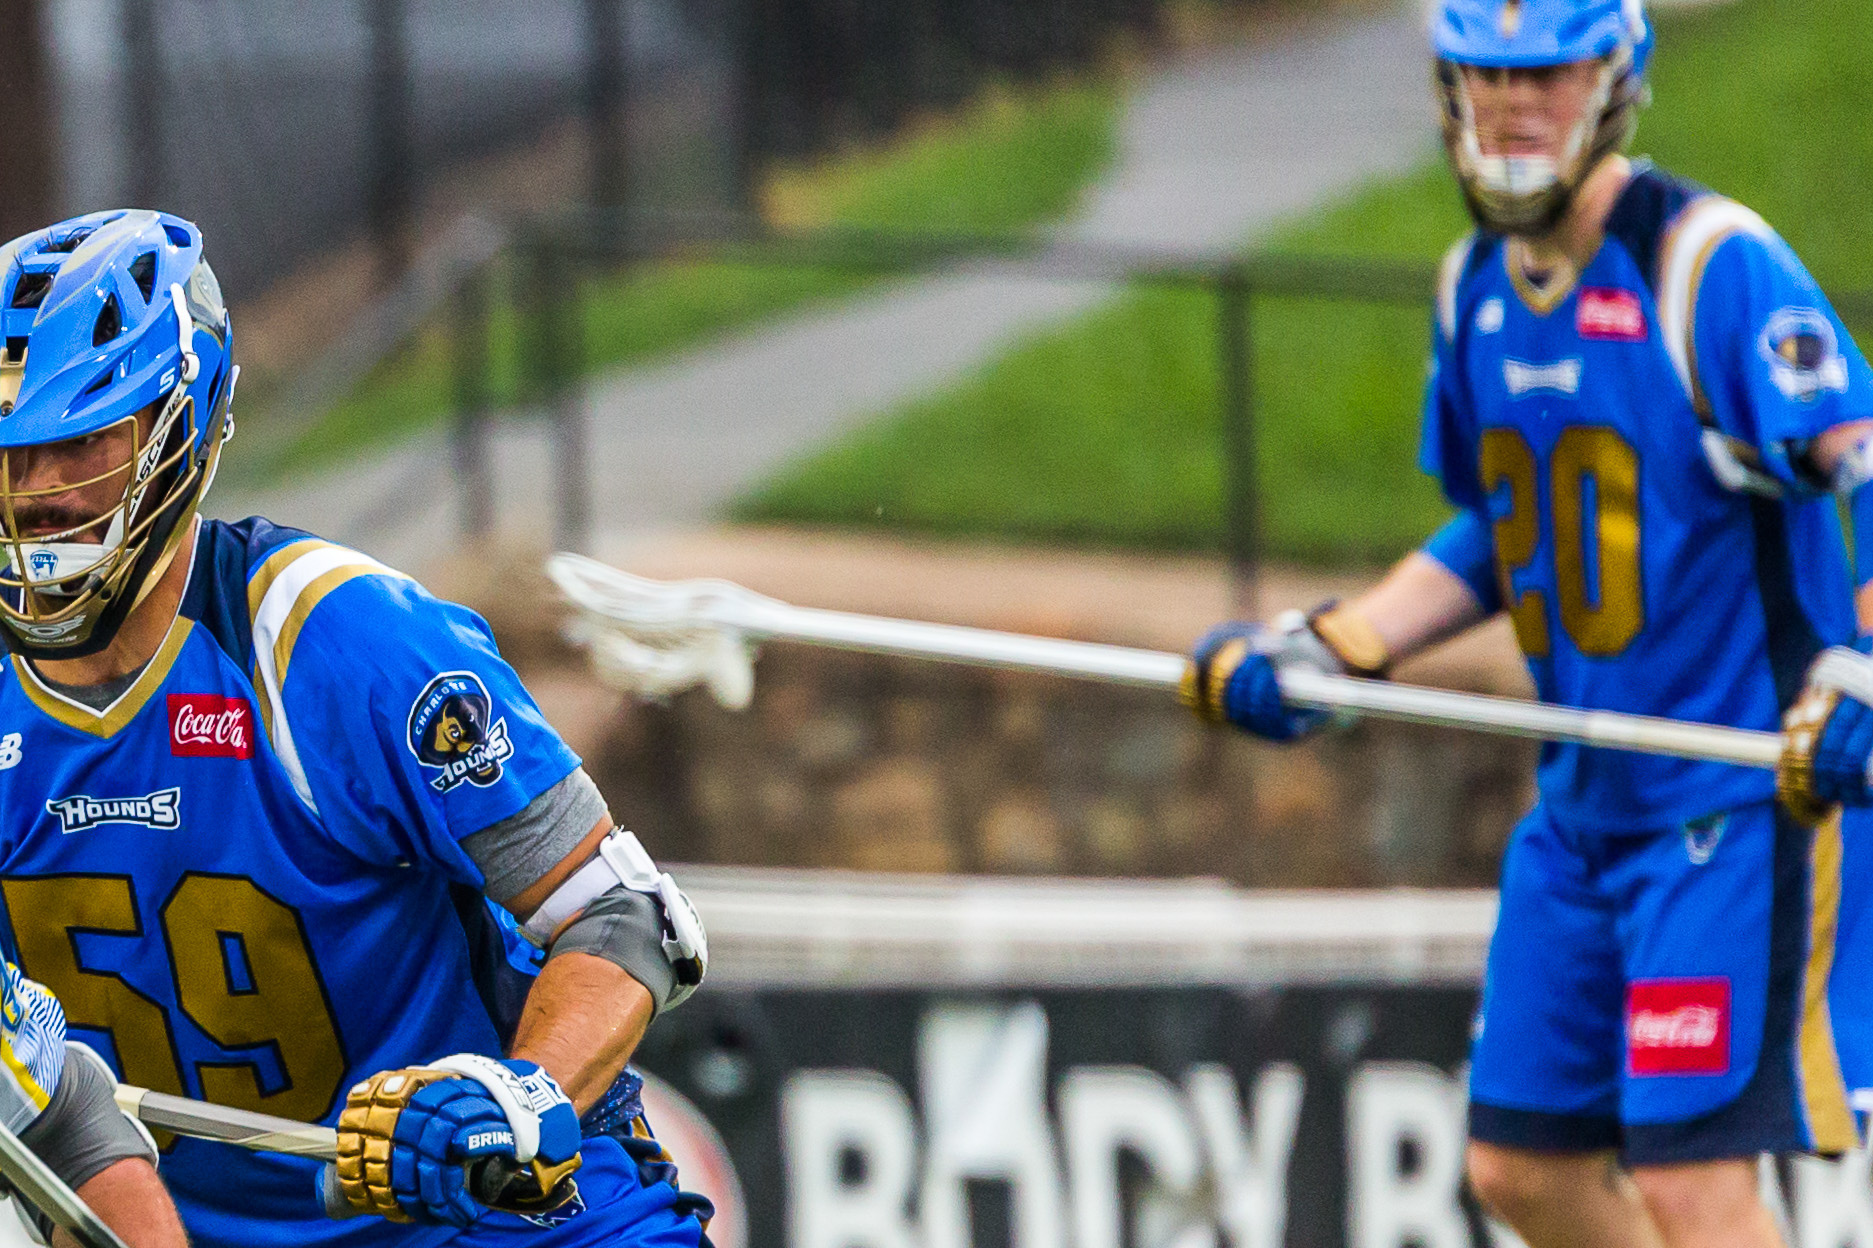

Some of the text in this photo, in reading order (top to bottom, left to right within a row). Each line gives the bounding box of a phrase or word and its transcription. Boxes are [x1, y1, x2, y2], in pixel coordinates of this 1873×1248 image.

[1479, 426, 1645, 658] 20
[174, 703, 248, 748] Coca-Ca
[437, 725, 510, 788] OUNS
[55, 794, 174, 827] HOUNDS
[468, 1130, 515, 1151] BRINE
